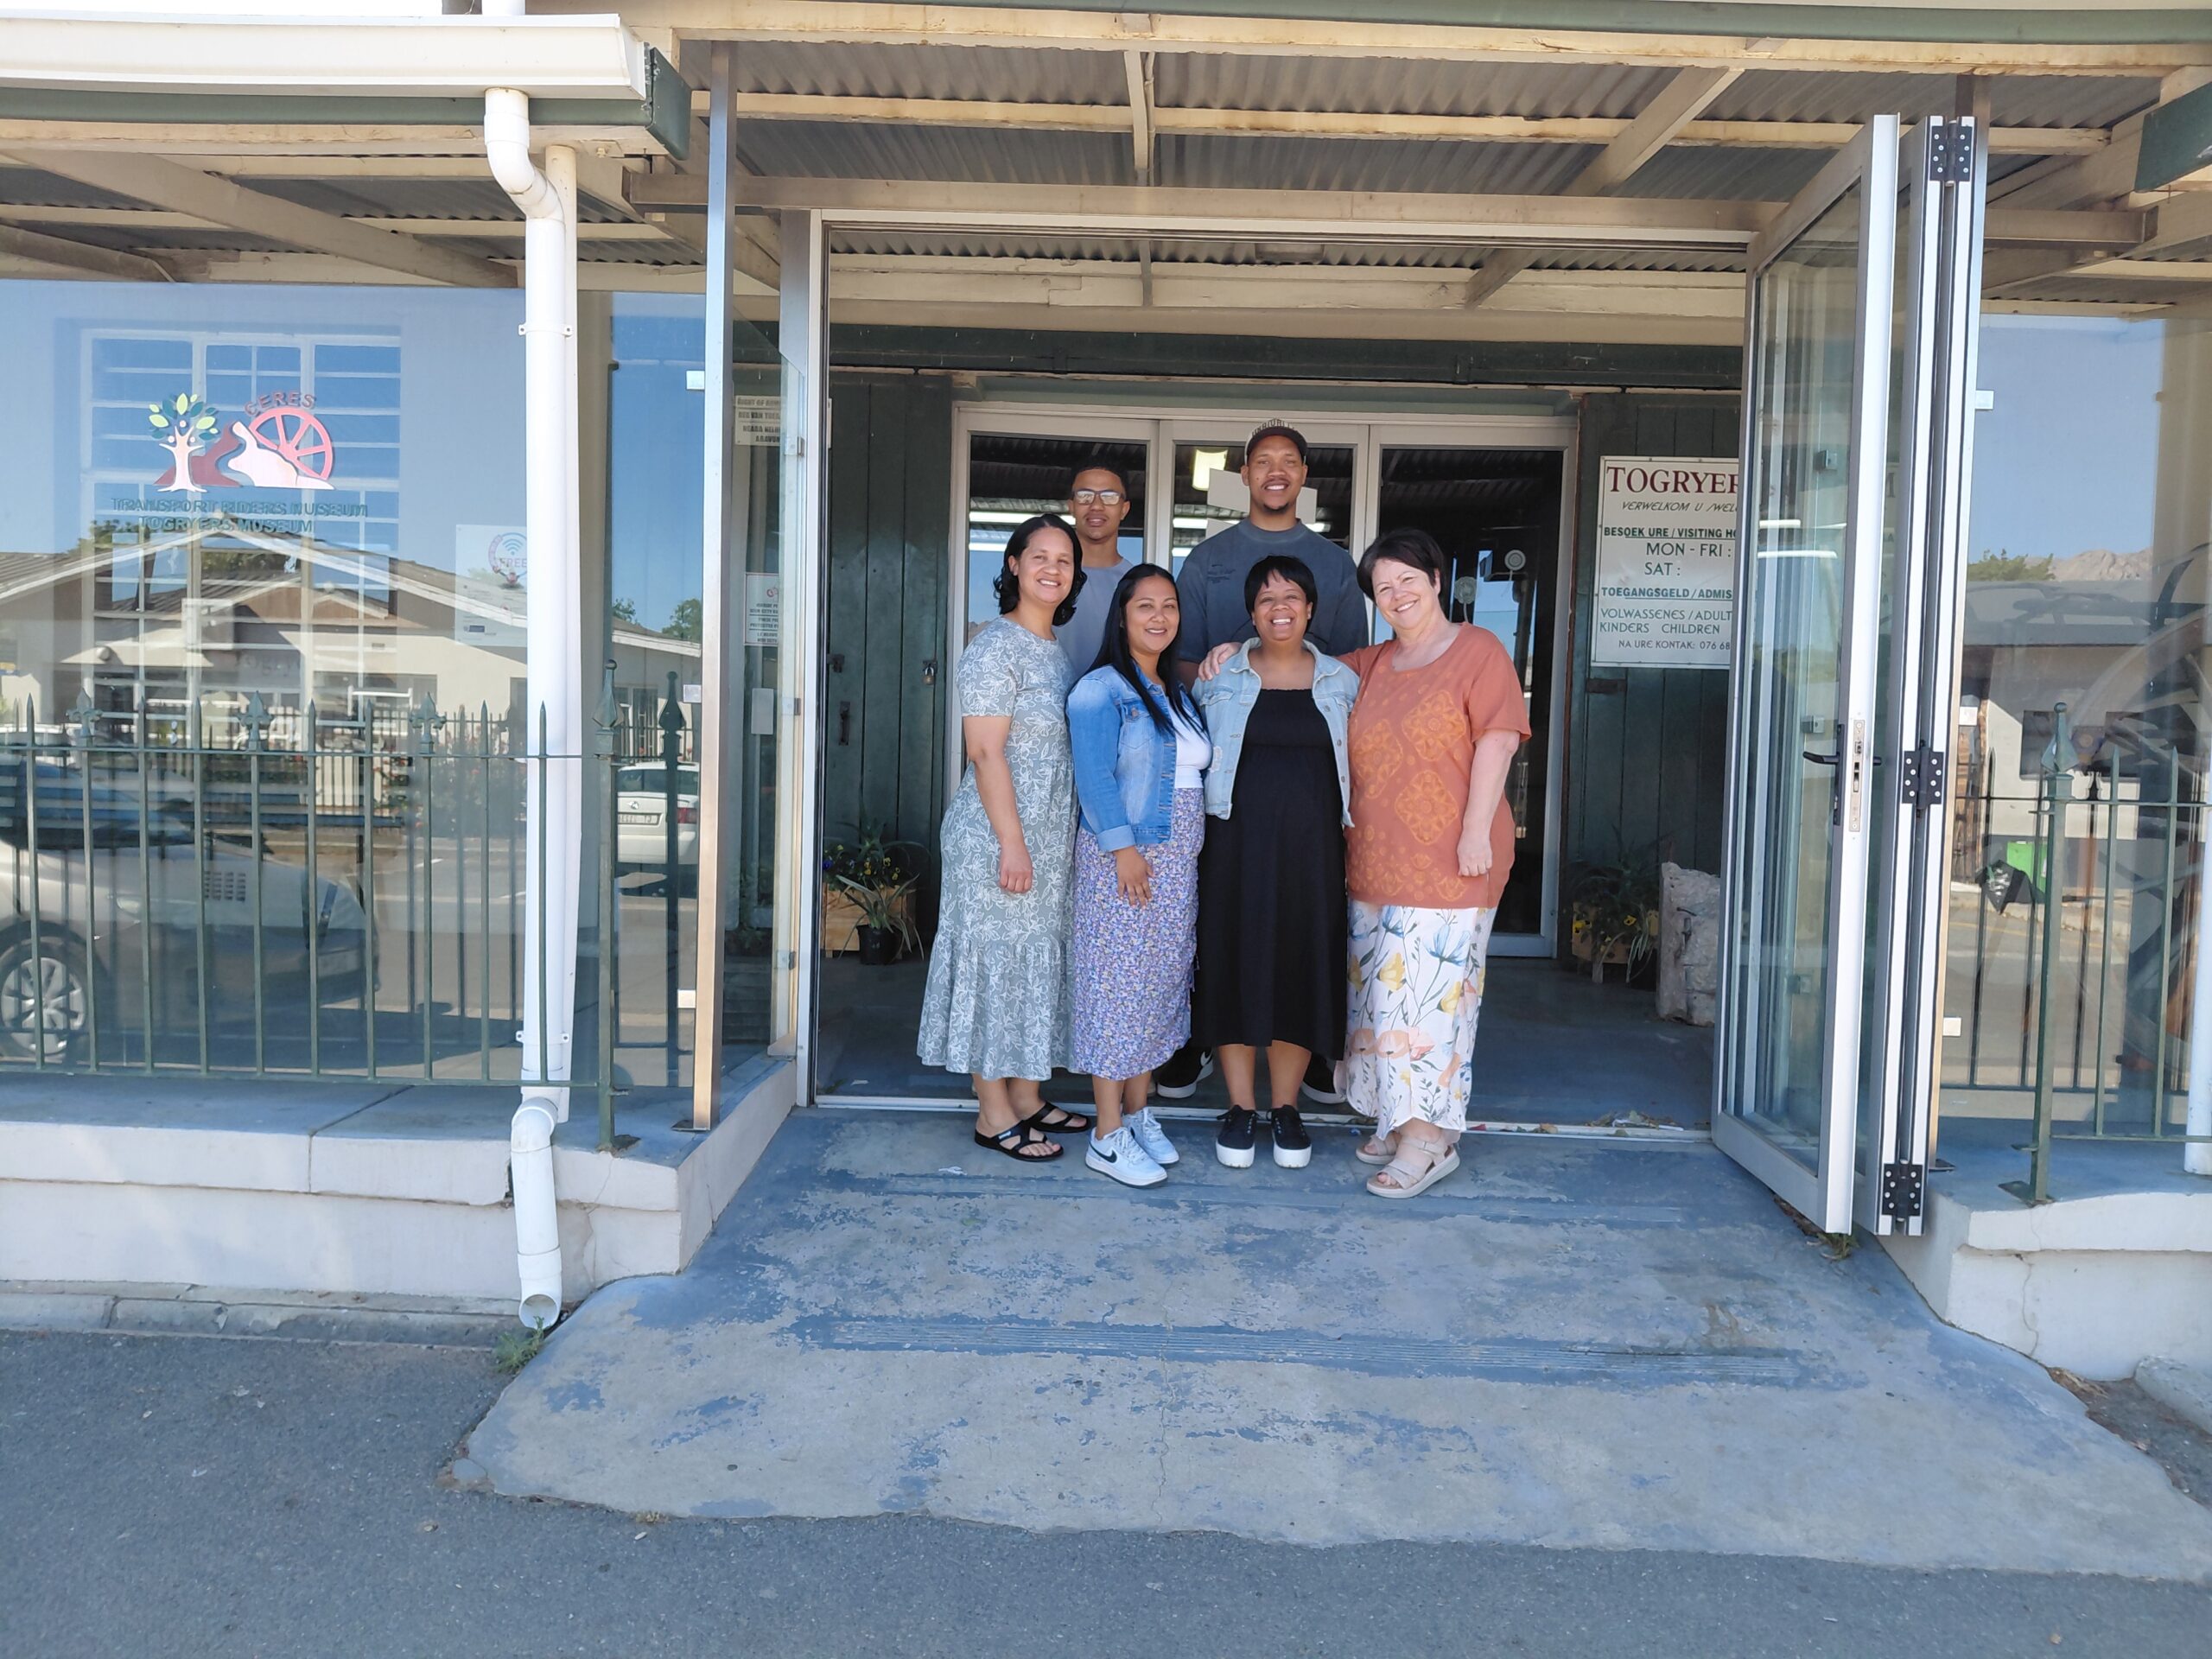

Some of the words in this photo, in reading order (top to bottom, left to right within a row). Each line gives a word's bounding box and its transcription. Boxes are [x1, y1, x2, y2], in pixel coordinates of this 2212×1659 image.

[245, 390, 316, 416] CERES
[110, 498, 216, 513] TRANSPORT
[220, 499, 288, 516] RIDERS
[290, 501, 368, 518] MUSEUM
[1622, 501, 1690, 512] VERWELKOM
[1694, 503, 1703, 512] U
[139, 516, 235, 531] TOGRYERS
[238, 518, 313, 533] MUSEUM
[1604, 526, 1645, 537] BESOEK
[1649, 527, 1669, 537] URE
[1677, 528, 1723, 538] VISITING
[1646, 542, 1686, 556] MON
[1602, 587, 1690, 598] TOEGANGSGELD
[1697, 588, 1732, 599] ADMIS
[1600, 607, 1686, 620] VOLWASSENES
[1599, 621, 1649, 633] KINDERS
[1662, 624, 1720, 635] CHILDREN
[1618, 639, 1632, 649] NA
[1635, 639, 1652, 649] URE
[1700, 641, 1717, 650] 076
